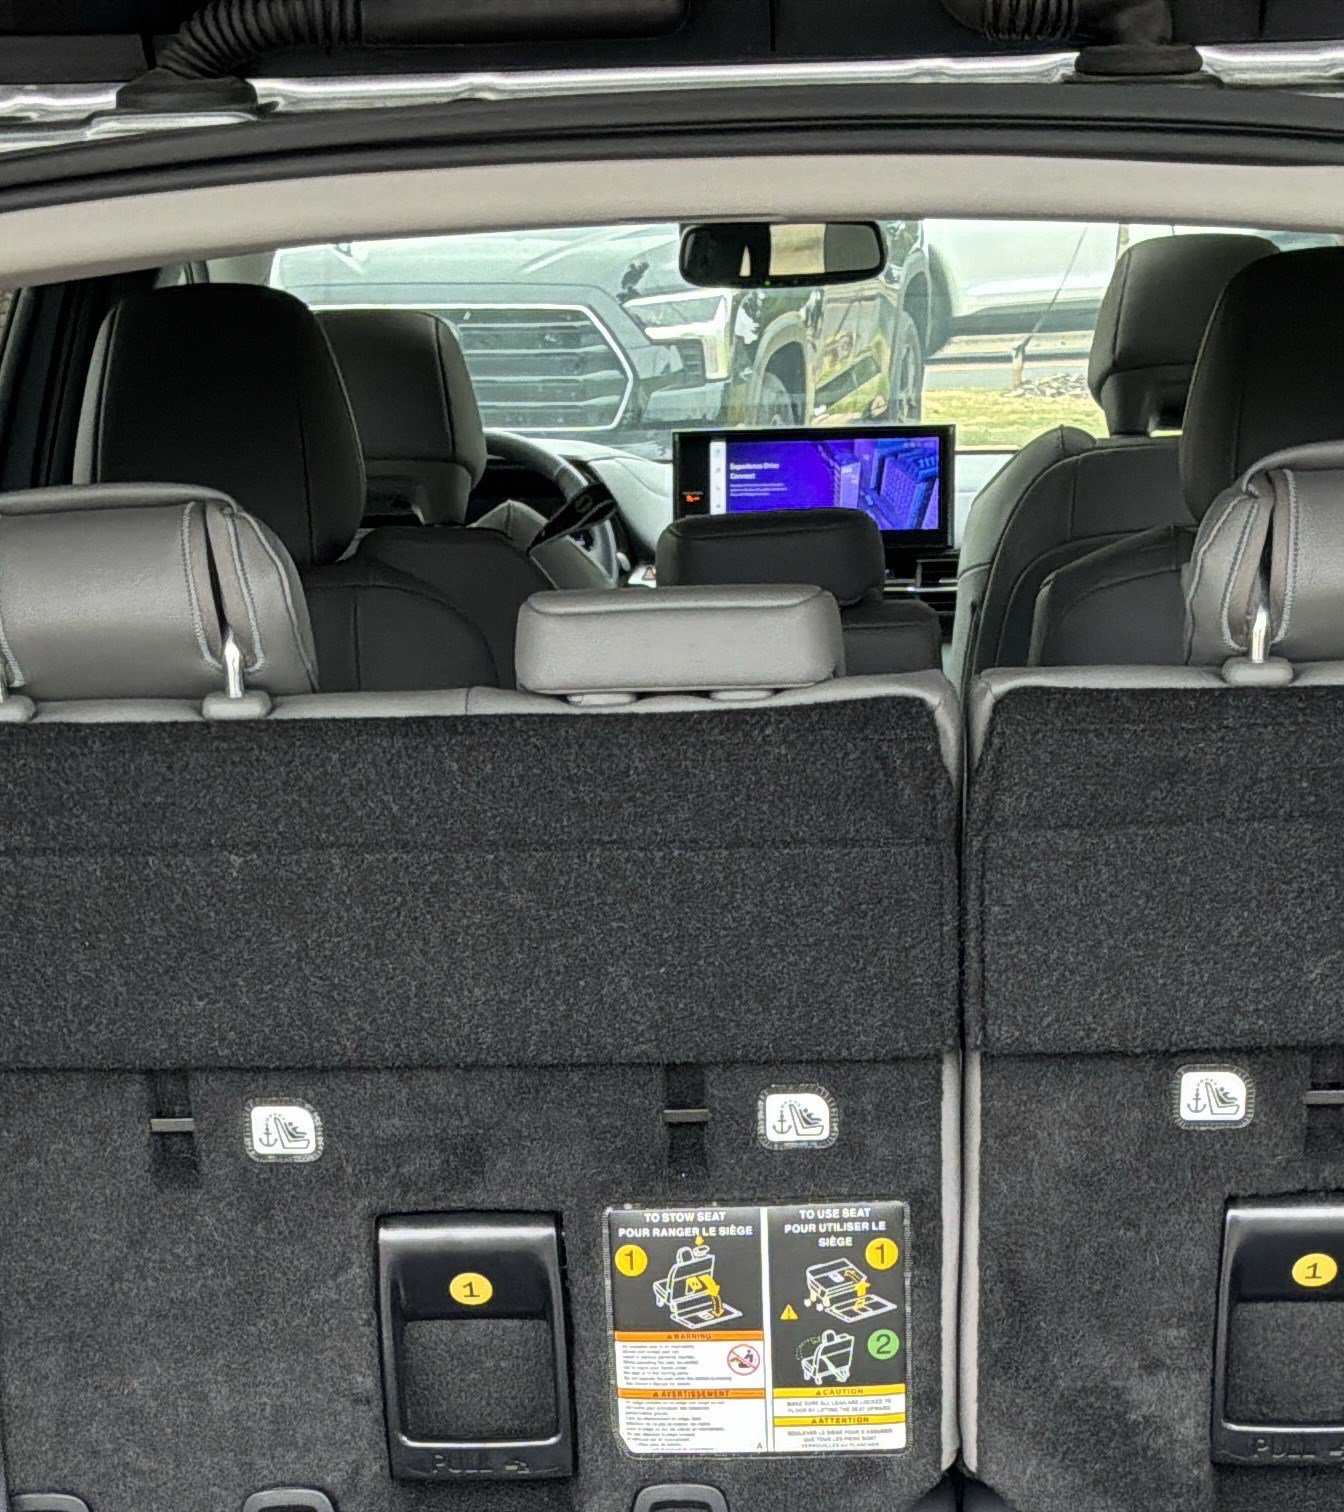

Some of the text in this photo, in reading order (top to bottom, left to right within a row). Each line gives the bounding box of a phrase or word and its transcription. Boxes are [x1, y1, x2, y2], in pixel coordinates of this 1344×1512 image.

[644, 1211, 726, 1223] TO STOW SEAT
[799, 1207, 872, 1220] TO USE SEAT
[618, 1224, 753, 1238] POUR RANGER LE SIÈGE
[784, 1220, 886, 1234] POUR UTILISER LE
[817, 1235, 853, 1247] SIÈGE
[624, 1249, 634, 1271] 1
[875, 1242, 885, 1264] 1
[1304, 1262, 1323, 1279] 1
[462, 1281, 481, 1298] 1
[876, 1333, 892, 1354] 2
[822, 1388, 864, 1396] CAUTION
[818, 1416, 870, 1424] ATTENTION
